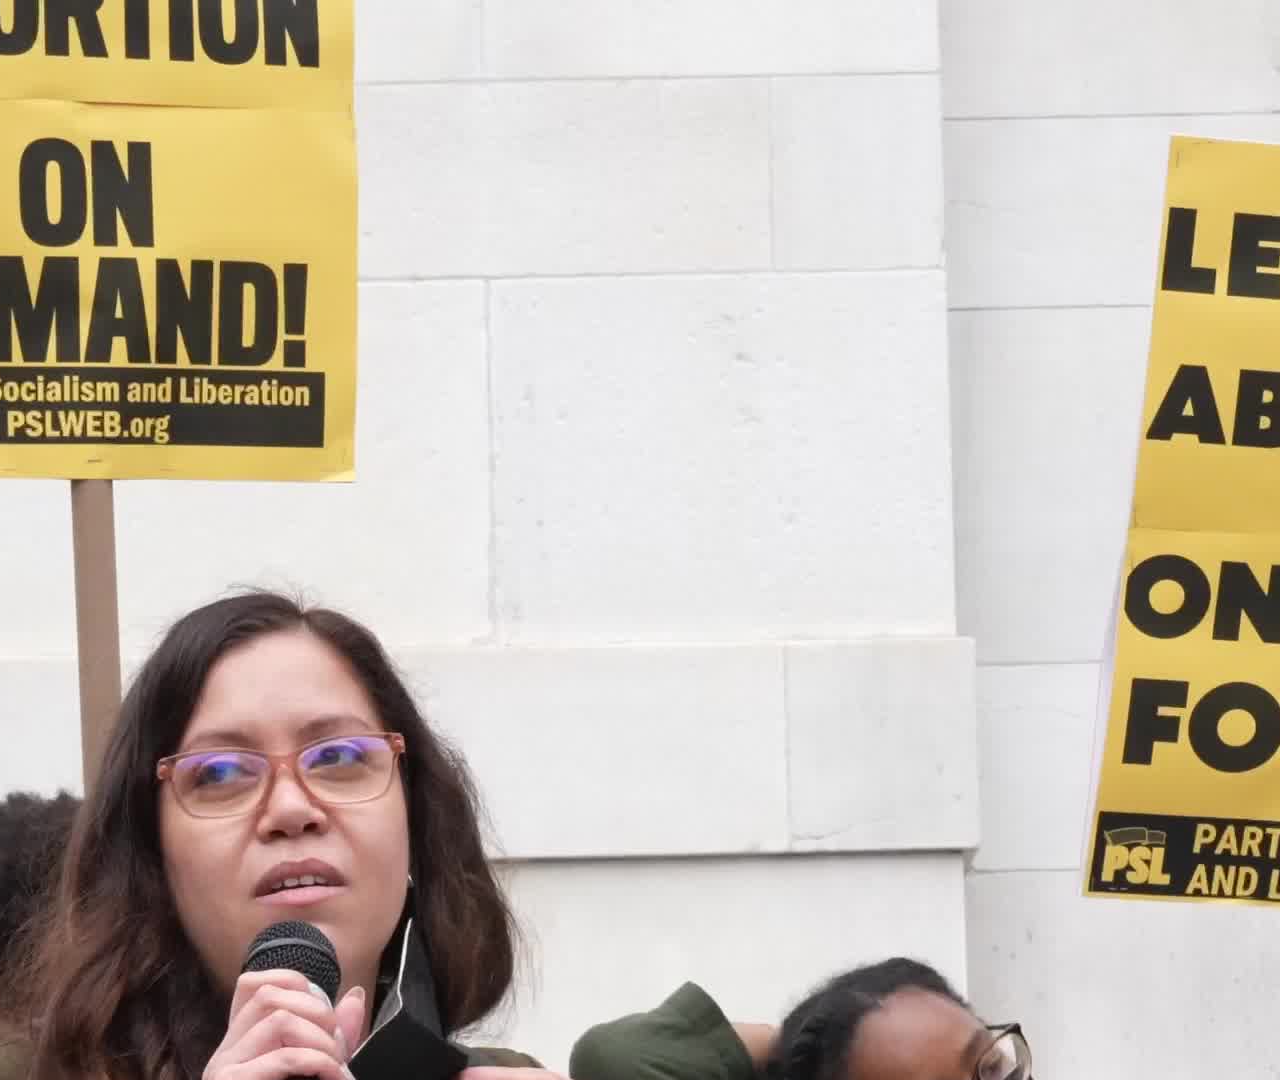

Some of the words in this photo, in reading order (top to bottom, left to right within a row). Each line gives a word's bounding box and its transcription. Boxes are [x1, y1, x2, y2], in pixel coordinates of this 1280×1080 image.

[18, 137, 155, 248] ON
[126, 376, 172, 403] and
[179, 377, 310, 407] Liberation
[7, 410, 171, 444] PSLWEB.org
[1101, 843, 1171, 886] PSL
[1185, 863, 1259, 897] AND
